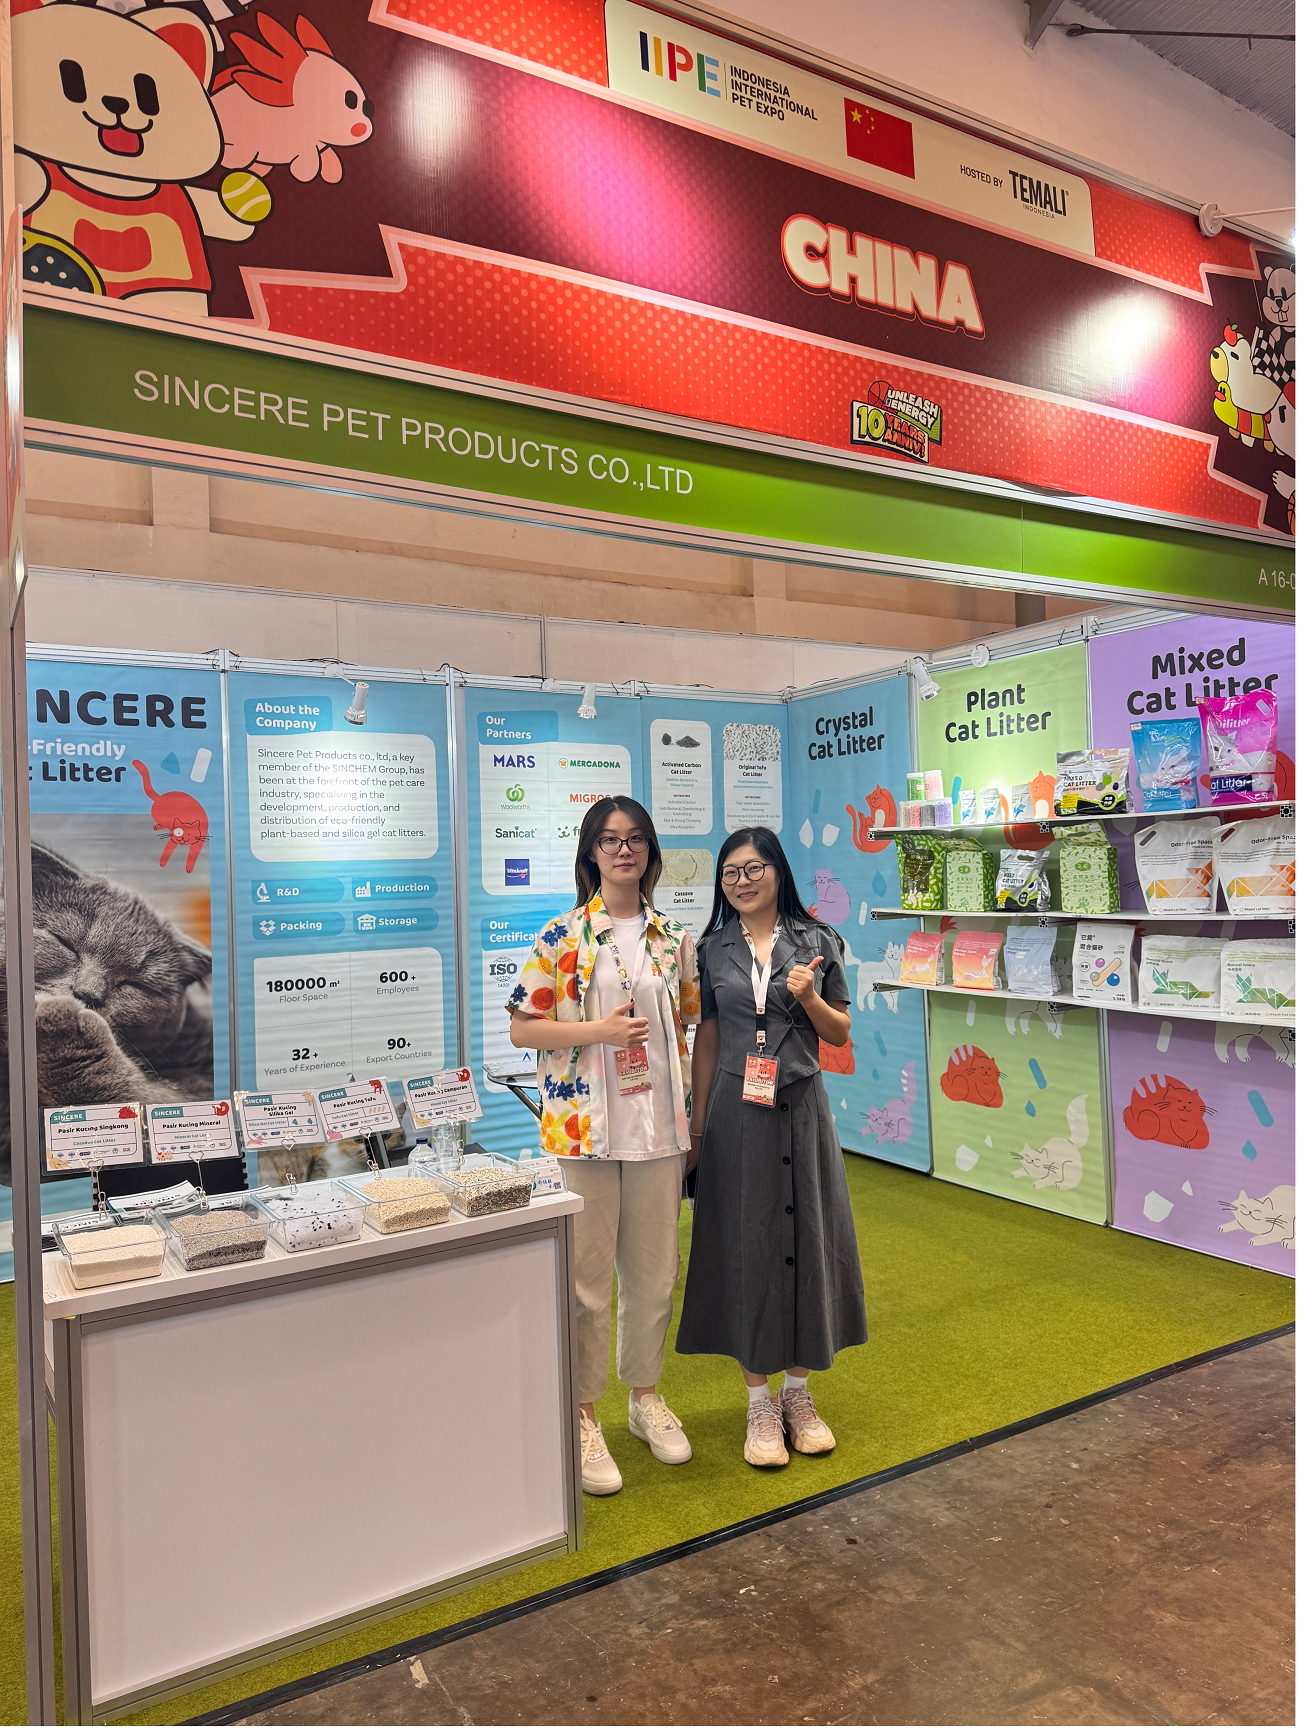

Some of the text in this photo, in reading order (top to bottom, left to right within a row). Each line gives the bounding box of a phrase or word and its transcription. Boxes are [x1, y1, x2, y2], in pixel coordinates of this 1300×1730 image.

[639, 31, 721, 98] IIPE
[730, 65, 791, 98] INDONESIA
[731, 79, 818, 121] INTERNATIONAL
[732, 92, 785, 121] PET EXPO
[960, 164, 1003, 188] HOSTED BY
[1023, 203, 1055, 219] INDONESIA
[780, 213, 986, 339] CHINA
[887, 389, 939, 419] UNLEASH
[890, 399, 935, 429] ENERGY
[857, 405, 886, 439] 10
[885, 413, 925, 444] YEARS
[133, 369, 694, 495] SINCERE PET PRODUCTS CO.,LTD
[884, 428, 925, 458] ANNIV!
[1258, 567, 1269, 586] A
[1151, 636, 1246, 680] Mixed
[966, 683, 1026, 712] Plant
[1127, 686, 1177, 715] Cat
[35, 688, 207, 729] NCERE
[255, 702, 320, 716] About the
[255, 716, 317, 732] Company
[485, 715, 506, 726] Our
[815, 706, 874, 737] Crystal
[945, 711, 1052, 743] Cat Litter
[486, 728, 532, 740] Partners
[808, 732, 885, 760] Cat Litter
[258, 748, 295, 758] Sincere
[296, 749, 313, 759] Pet
[315, 750, 358, 760] Products
[376, 752, 391, 762] ltd,
[399, 752, 415, 764] key
[493, 754, 536, 769] MARS
[42, 759, 127, 782] Litter
[258, 762, 425, 776] member of the SINCHEM Group, has
[569, 759, 621, 769] MERCADONA
[259, 775, 425, 788] been at the forefront of the pet care
[259, 788, 385, 801] industry, specializing in the
[259, 801, 400, 814] development, production, and
[500, 803, 531, 811] Woolworths
[260, 815, 386, 827] distribution of eco-friendly
[260, 828, 426, 840] plant-based and silica gel cat litters.
[495, 826, 534, 839] Sanicat
[276, 887, 300, 897] R&D
[375, 883, 430, 893] Production
[280, 920, 323, 931] Packing
[378, 916, 418, 927] Storage
[489, 920, 509, 930] Our
[489, 963, 518, 976] ISO
[379, 970, 409, 984] 600
[266, 976, 327, 993] 180000
[376, 985, 420, 995] Employees
[279, 992, 329, 1004] Floor Space
[291, 1047, 311, 1061] 32
[366, 1050, 432, 1064] Export Countries
[264, 1059, 346, 1076] Years of Experience
[409, 1079, 432, 1088] SINCERE
[245, 1097, 270, 1105] SINCERE
[320, 1091, 345, 1100] SINCERE
[53, 1113, 83, 1121] SINCERE
[154, 1109, 180, 1117] SINCERE
